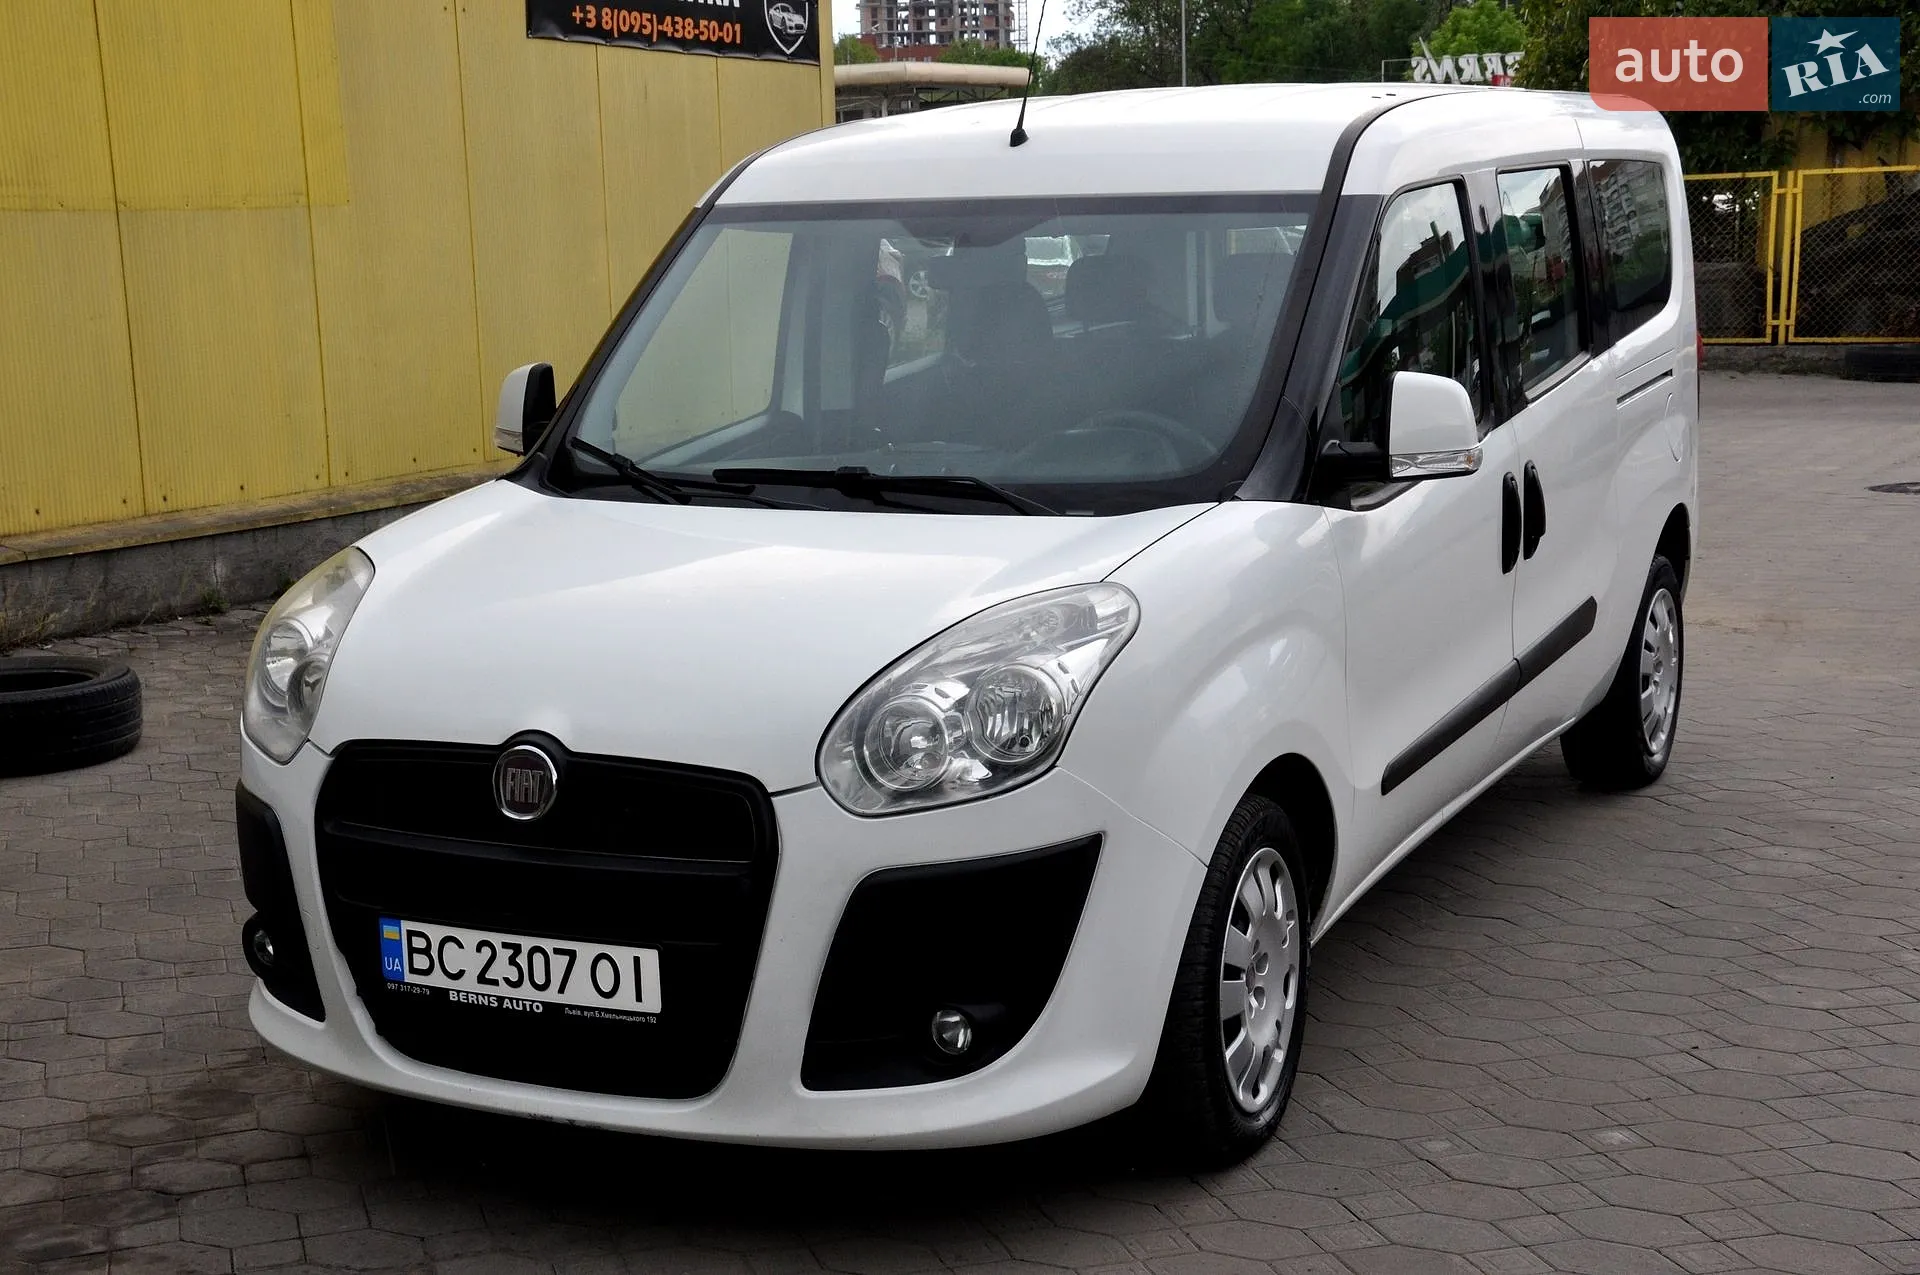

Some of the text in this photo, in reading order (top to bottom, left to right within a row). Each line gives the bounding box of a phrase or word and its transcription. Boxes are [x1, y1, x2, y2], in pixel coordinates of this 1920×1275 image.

[506, 767, 544, 804] FIAT
[384, 957, 402, 972] UA
[449, 990, 543, 1013] BERNS AUTO
